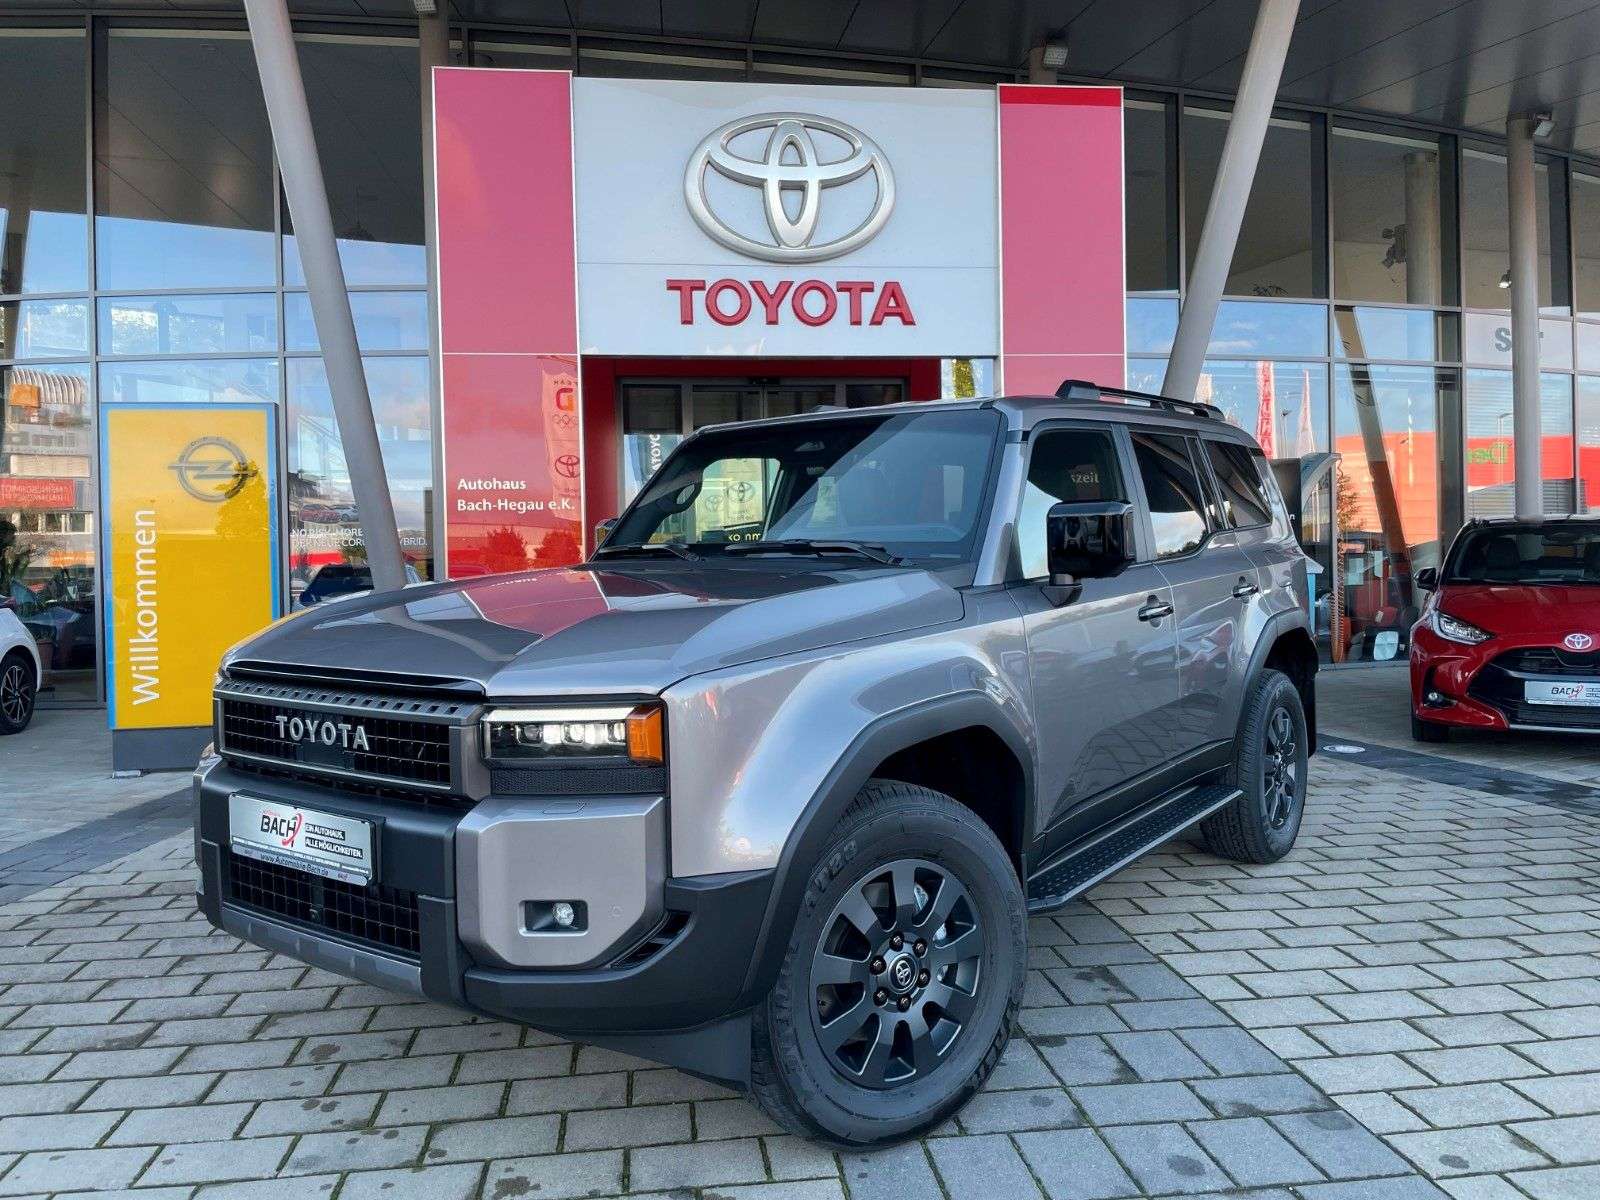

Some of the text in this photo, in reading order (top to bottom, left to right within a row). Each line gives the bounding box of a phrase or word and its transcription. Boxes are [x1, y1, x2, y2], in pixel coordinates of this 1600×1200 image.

[666, 278, 916, 327] TOYOTA
[457, 478, 526, 490] Autohaus
[457, 498, 576, 514] Bach-Hegau e.K.
[128, 510, 160, 705] Willkommen
[1551, 686, 1580, 695] BACH
[275, 714, 370, 751] TOYOTA
[260, 814, 298, 838] BACH
[305, 837, 319, 848] ALLE
